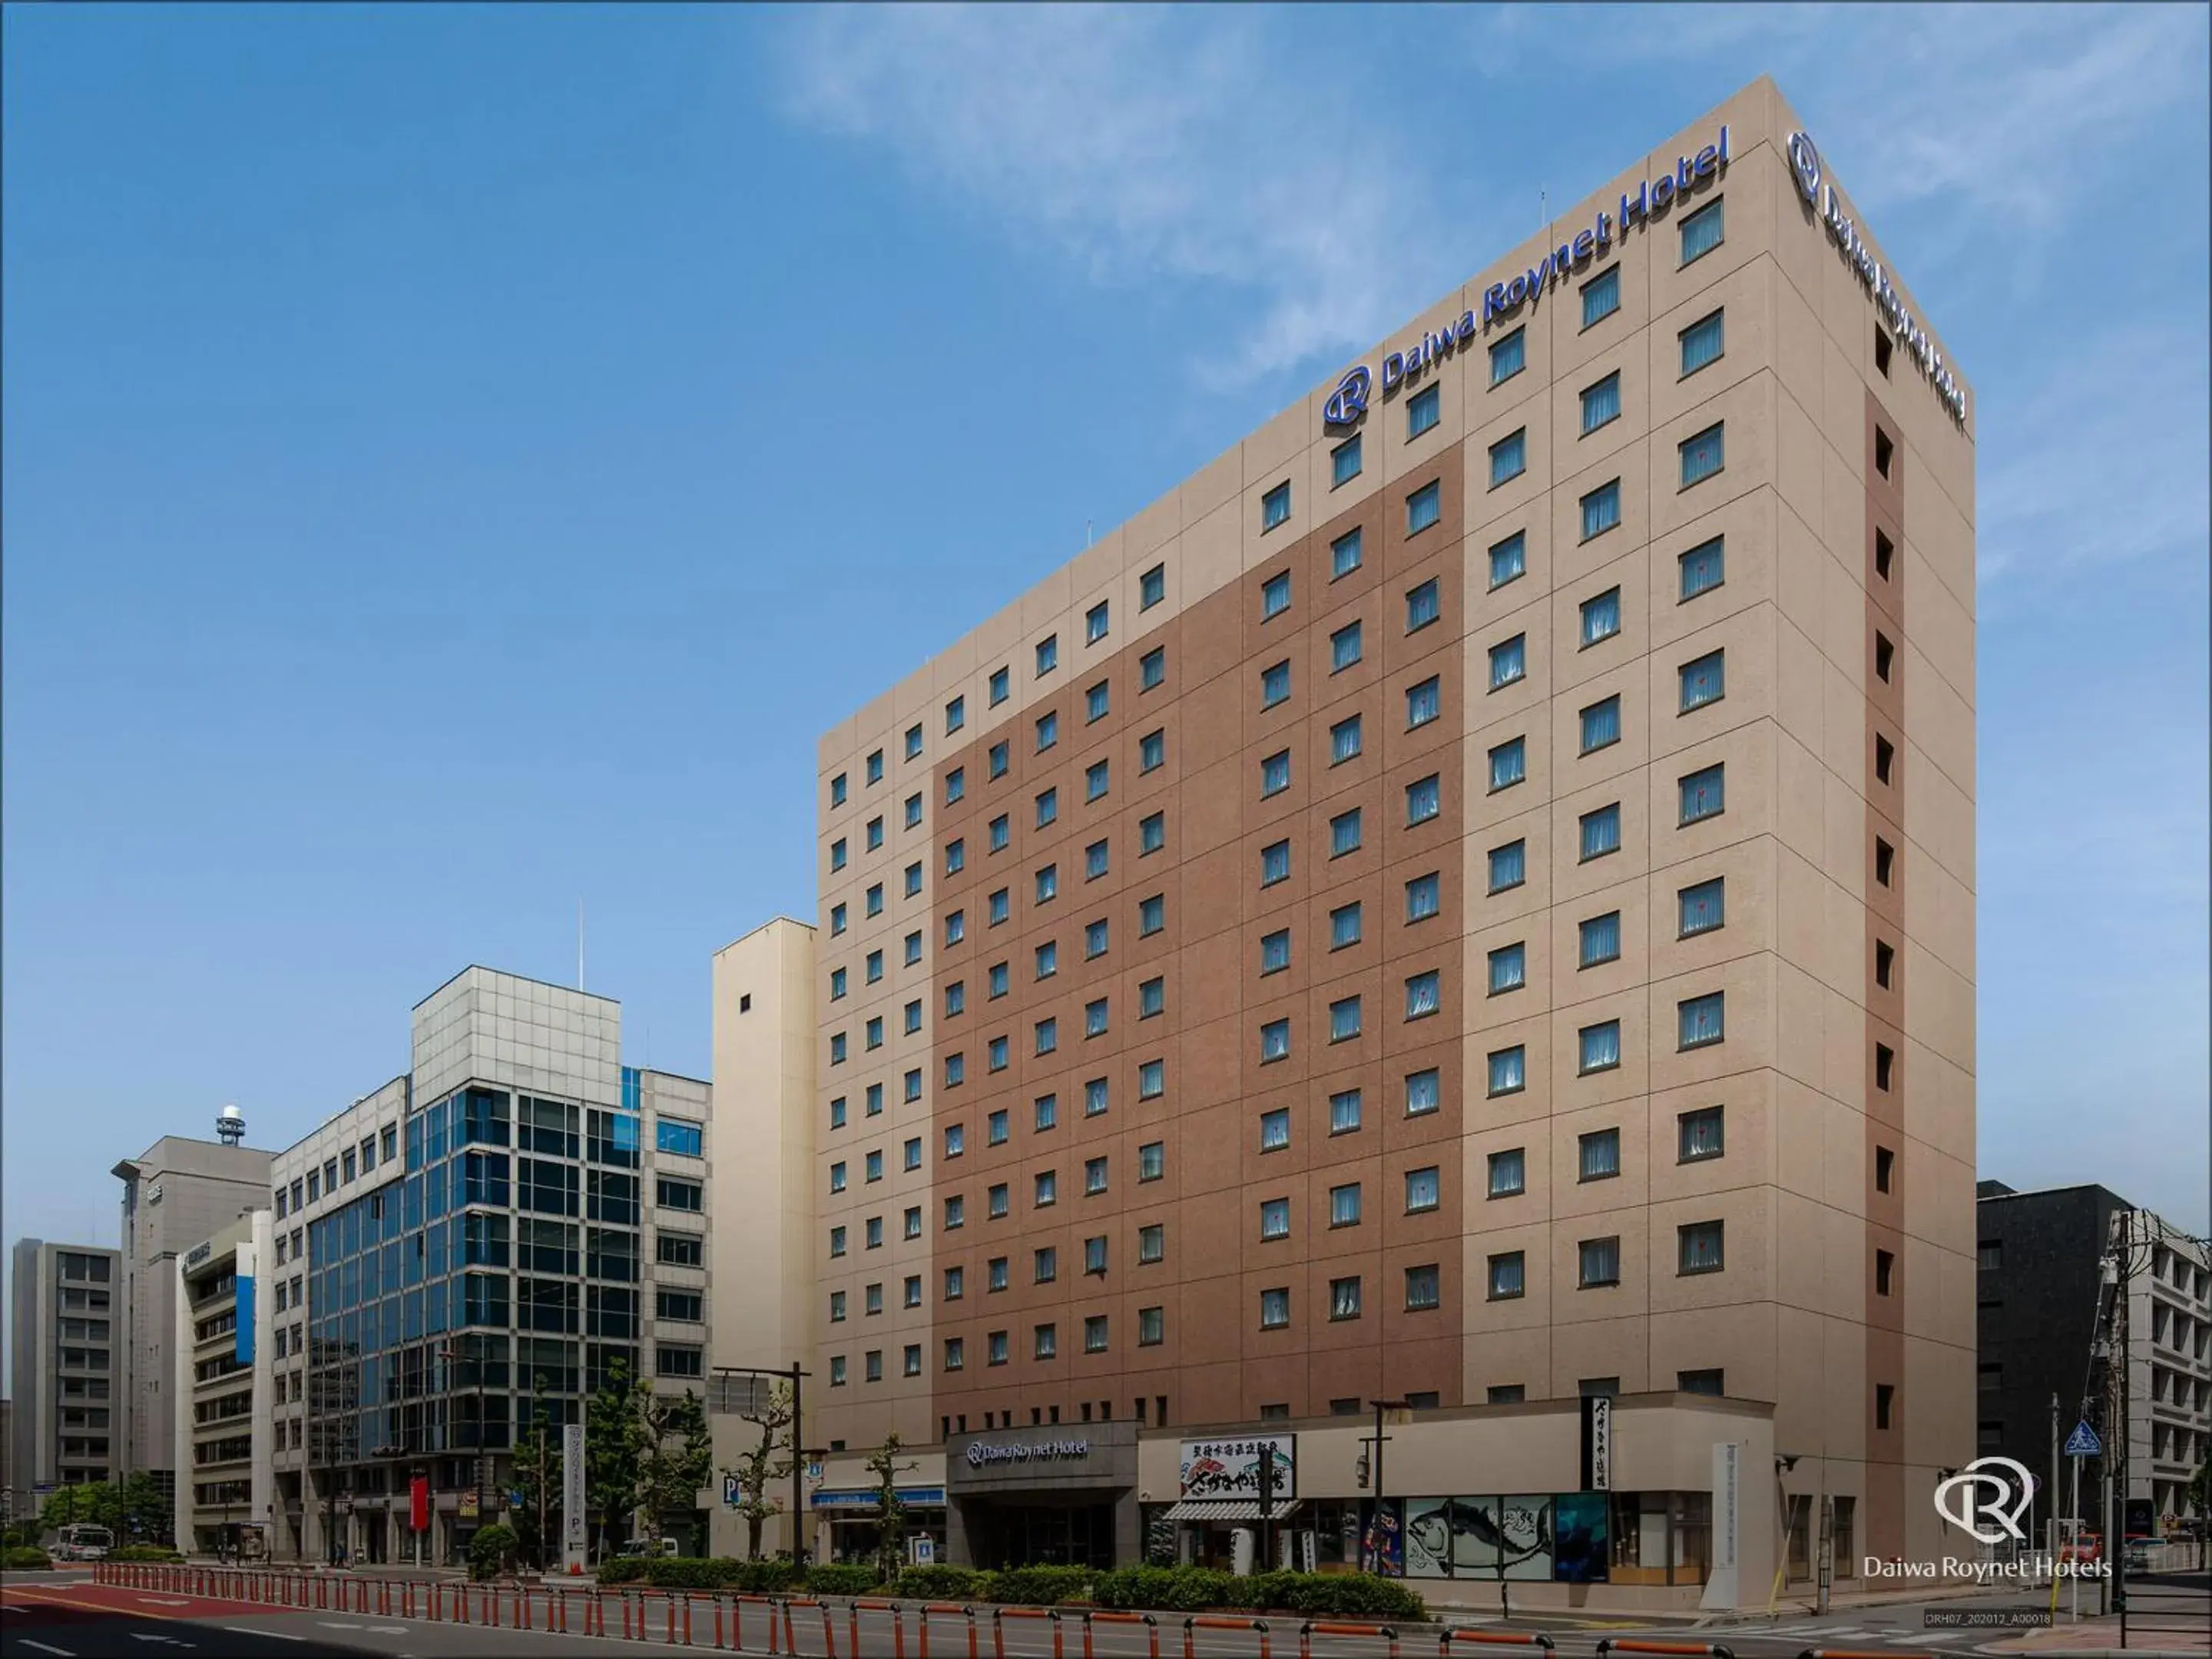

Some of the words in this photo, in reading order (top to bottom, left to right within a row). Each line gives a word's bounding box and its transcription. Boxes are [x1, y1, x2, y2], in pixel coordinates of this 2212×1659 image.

[1382, 309, 1475, 389] Daiwa
[1483, 212, 1612, 323] Roynet
[1621, 124, 1730, 227] Hotel
[982, 1445, 1012, 1459] Daiwa
[1013, 1442, 1051, 1459] Roynet
[1054, 1439, 1087, 1453] Hotel
